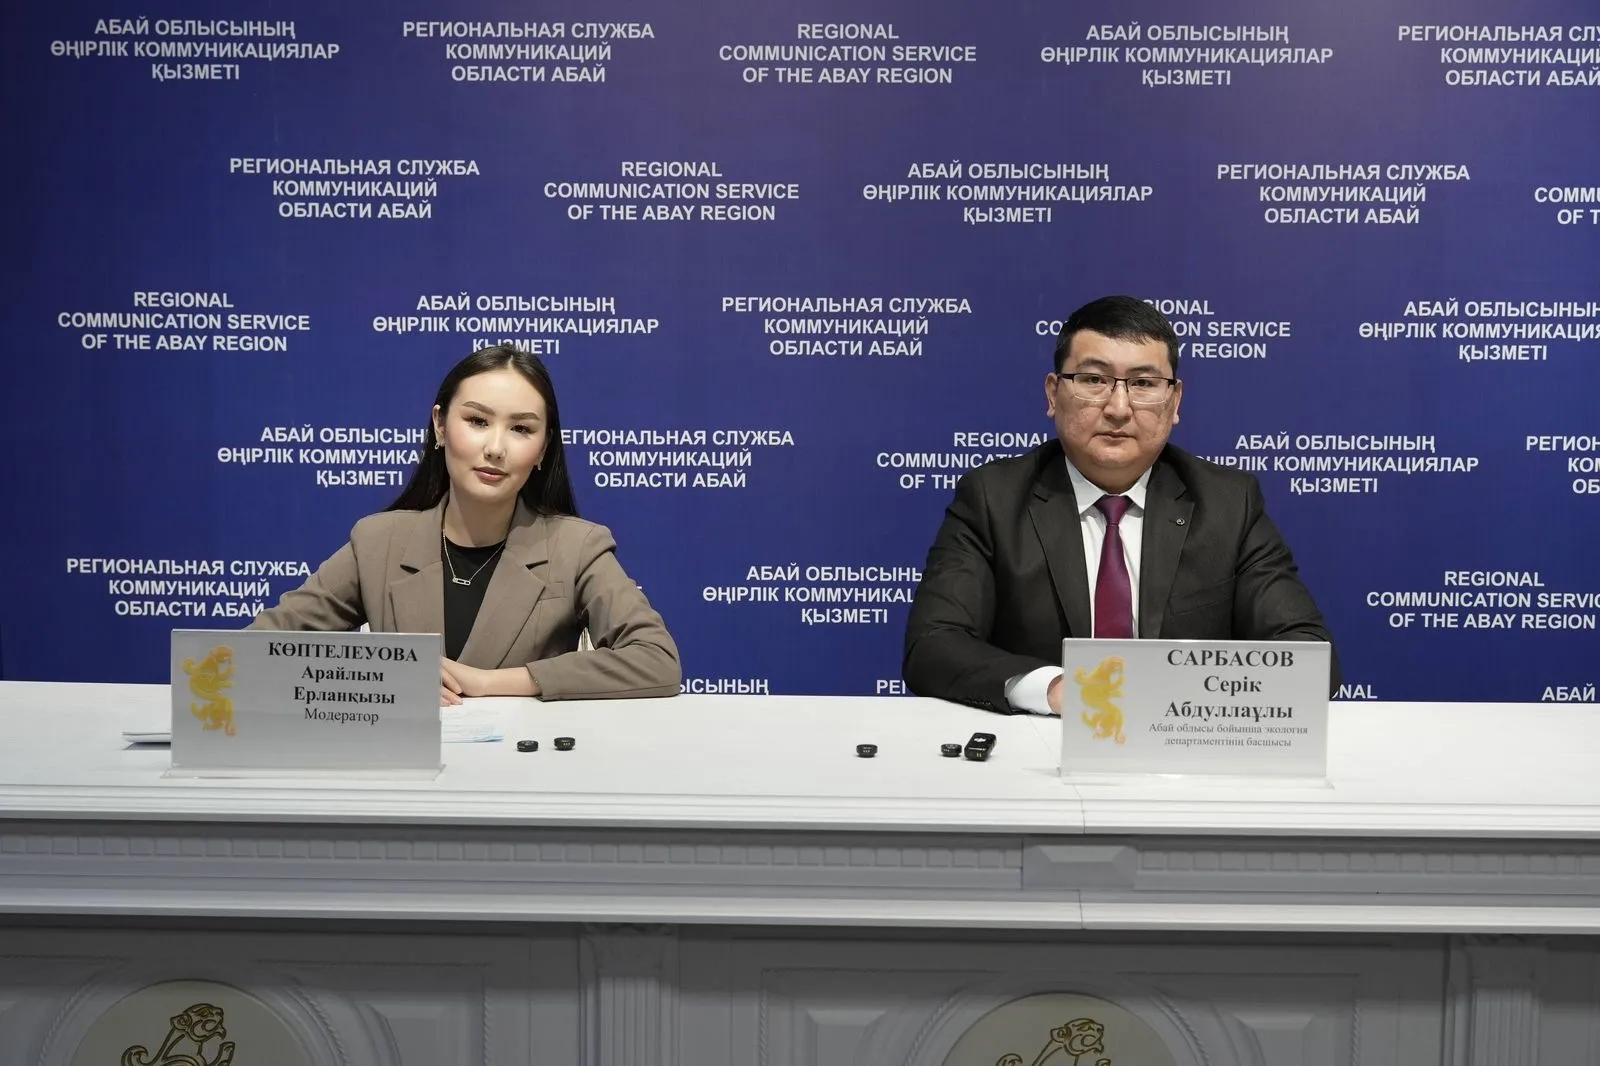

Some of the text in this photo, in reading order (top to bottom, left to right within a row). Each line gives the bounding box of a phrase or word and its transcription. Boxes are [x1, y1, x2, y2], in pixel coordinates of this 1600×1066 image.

[95, 16, 296, 40] АБАЙ ОБЛЫСЫНЫҢ
[403, 21, 655, 39] РЕГИОНАЛЬНАЯ СЛУЖБА
[797, 23, 900, 40] REGIONAL
[1085, 21, 1289, 45] АБАЙ ОБЛЫСЫНЫҢ
[1398, 25, 1563, 42] РЕГИОНАЛЬНАЯ
[51, 41, 340, 61] ӨҢІРЛІК КОММУНИКАЦИЯЛАР
[446, 41, 611, 64] КОММУНИКАЦИЙ
[719, 45, 977, 62] COMMUNICATION SERVICE
[1040, 46, 1334, 67] ӨҢІРЛІК КОММУНИКАЦИЯЛАР
[152, 64, 239, 82] ҚЫЗМЕТІ
[451, 63, 606, 83] ОБЛАСТИ АБАЙ
[742, 67, 952, 84] OF THE ABAY REGION
[1142, 69, 1231, 88] ҚЫЗМЕТІ
[1445, 66, 1600, 86] ОБЛАСТИ АБАЙ
[230, 158, 480, 176] РЕГИОНАЛЬНАЯ СЛУЖБА
[621, 161, 723, 177] REGIONAL
[907, 159, 1109, 183] АБАЙ ОБЛЫСЫНЫҢ
[1217, 163, 1471, 181] РЕГИОНАЛЬНАЯ СЛУЖБА
[273, 177, 437, 200] КОММУНИКАЦИЙ
[543, 182, 799, 199] COMMUNICATION SERVICE
[862, 184, 1153, 204] ӨҢІРЛІК КОММУНИКАЦИЯЛАР
[1259, 182, 1426, 205] КОММУНИКАЦИЙ
[278, 199, 432, 219] ОБЛАСТИ АБАЙ
[567, 204, 776, 221] OF THE ABAY REGION
[963, 207, 1052, 225] ҚЫЗМЕТІ
[1264, 204, 1420, 224] ОБЛАСТИ АБАЙ
[1557, 208, 1584, 225] OF
[134, 291, 234, 308] REGIONAL
[416, 291, 616, 315] АБАЙ ОБЛЫСЫНЫҢ
[722, 296, 972, 314] РЕГИОНАЛЬНАЯ СЛУЖБА
[1143, 299, 1215, 315] IONAL
[1403, 297, 1459, 317] АБАЙ
[58, 312, 310, 331] COMMUNICATION SERVICE
[372, 316, 659, 337] ӨҢІРЛІК КОММУНИКАЦИЯЛАР
[764, 315, 929, 338] КОММУНИКАЦИЙ
[1207, 321, 1291, 338] SERVICE
[1358, 322, 1600, 342] ӨҢІРЛІК КОММУНИКАЦИ
[81, 333, 287, 352] OF THE ABAY REGION
[769, 337, 923, 356] ОБЛАСТИ АБАЙ
[1191, 342, 1267, 359] REGION
[1458, 344, 1547, 363] ҚЫЗМЕТІ
[260, 423, 428, 444] АБАЙ ОБЛЫСЫН
[560, 429, 794, 446] ЕГИОНАЛЬНАЯ СЛУЖБА
[1235, 431, 1436, 454] АБАЙ ОБЛЫСЫНЫҢ
[217, 447, 422, 466] ӨҢІРЛІК КОММУНИКА
[589, 447, 752, 470] КОММУНИКАЦИЙ
[1273, 456, 1479, 475] КОММУНИКАЦИЯЛАР
[316, 470, 403, 488] ҚЫЗМЕТІ
[594, 468, 746, 488] ОБЛАСТИ АБАЙ
[899, 473, 963, 490] OF TH
[1290, 477, 1378, 496] ҚЫЗМЕТІ
[67, 558, 312, 577] РЕГИОНАЛЬНАЯ СЛУЖБА
[746, 562, 800, 581] АБАЙ
[109, 577, 270, 599] КОММУНИКАЦИЙ
[1444, 571, 1545, 587] REGIONAL
[702, 586, 780, 605] ӨҢІРЛІК
[1366, 591, 1531, 608] COMMUNICATION
[115, 600, 206, 617] ОБЛАСТИ
[801, 608, 888, 626] ҚЫЗМЕТІ
[1389, 612, 1596, 629] OF THE ABAY REGION
[268, 641, 419, 662] КӨПТЕЛЕУОВА
[1166, 649, 1295, 668] САРБАСОВ
[300, 665, 384, 683] Арайлым
[293, 686, 396, 705] Ерланқызы
[1203, 675, 1262, 697] Серік
[1541, 682, 1596, 702] АБАЙ
[303, 707, 380, 726] Модератор
[1164, 701, 1293, 723] Абдуллаұлы
[1148, 722, 1309, 735] Абай облысы бойынша экология
[1245, 736, 1292, 747] басшысы
